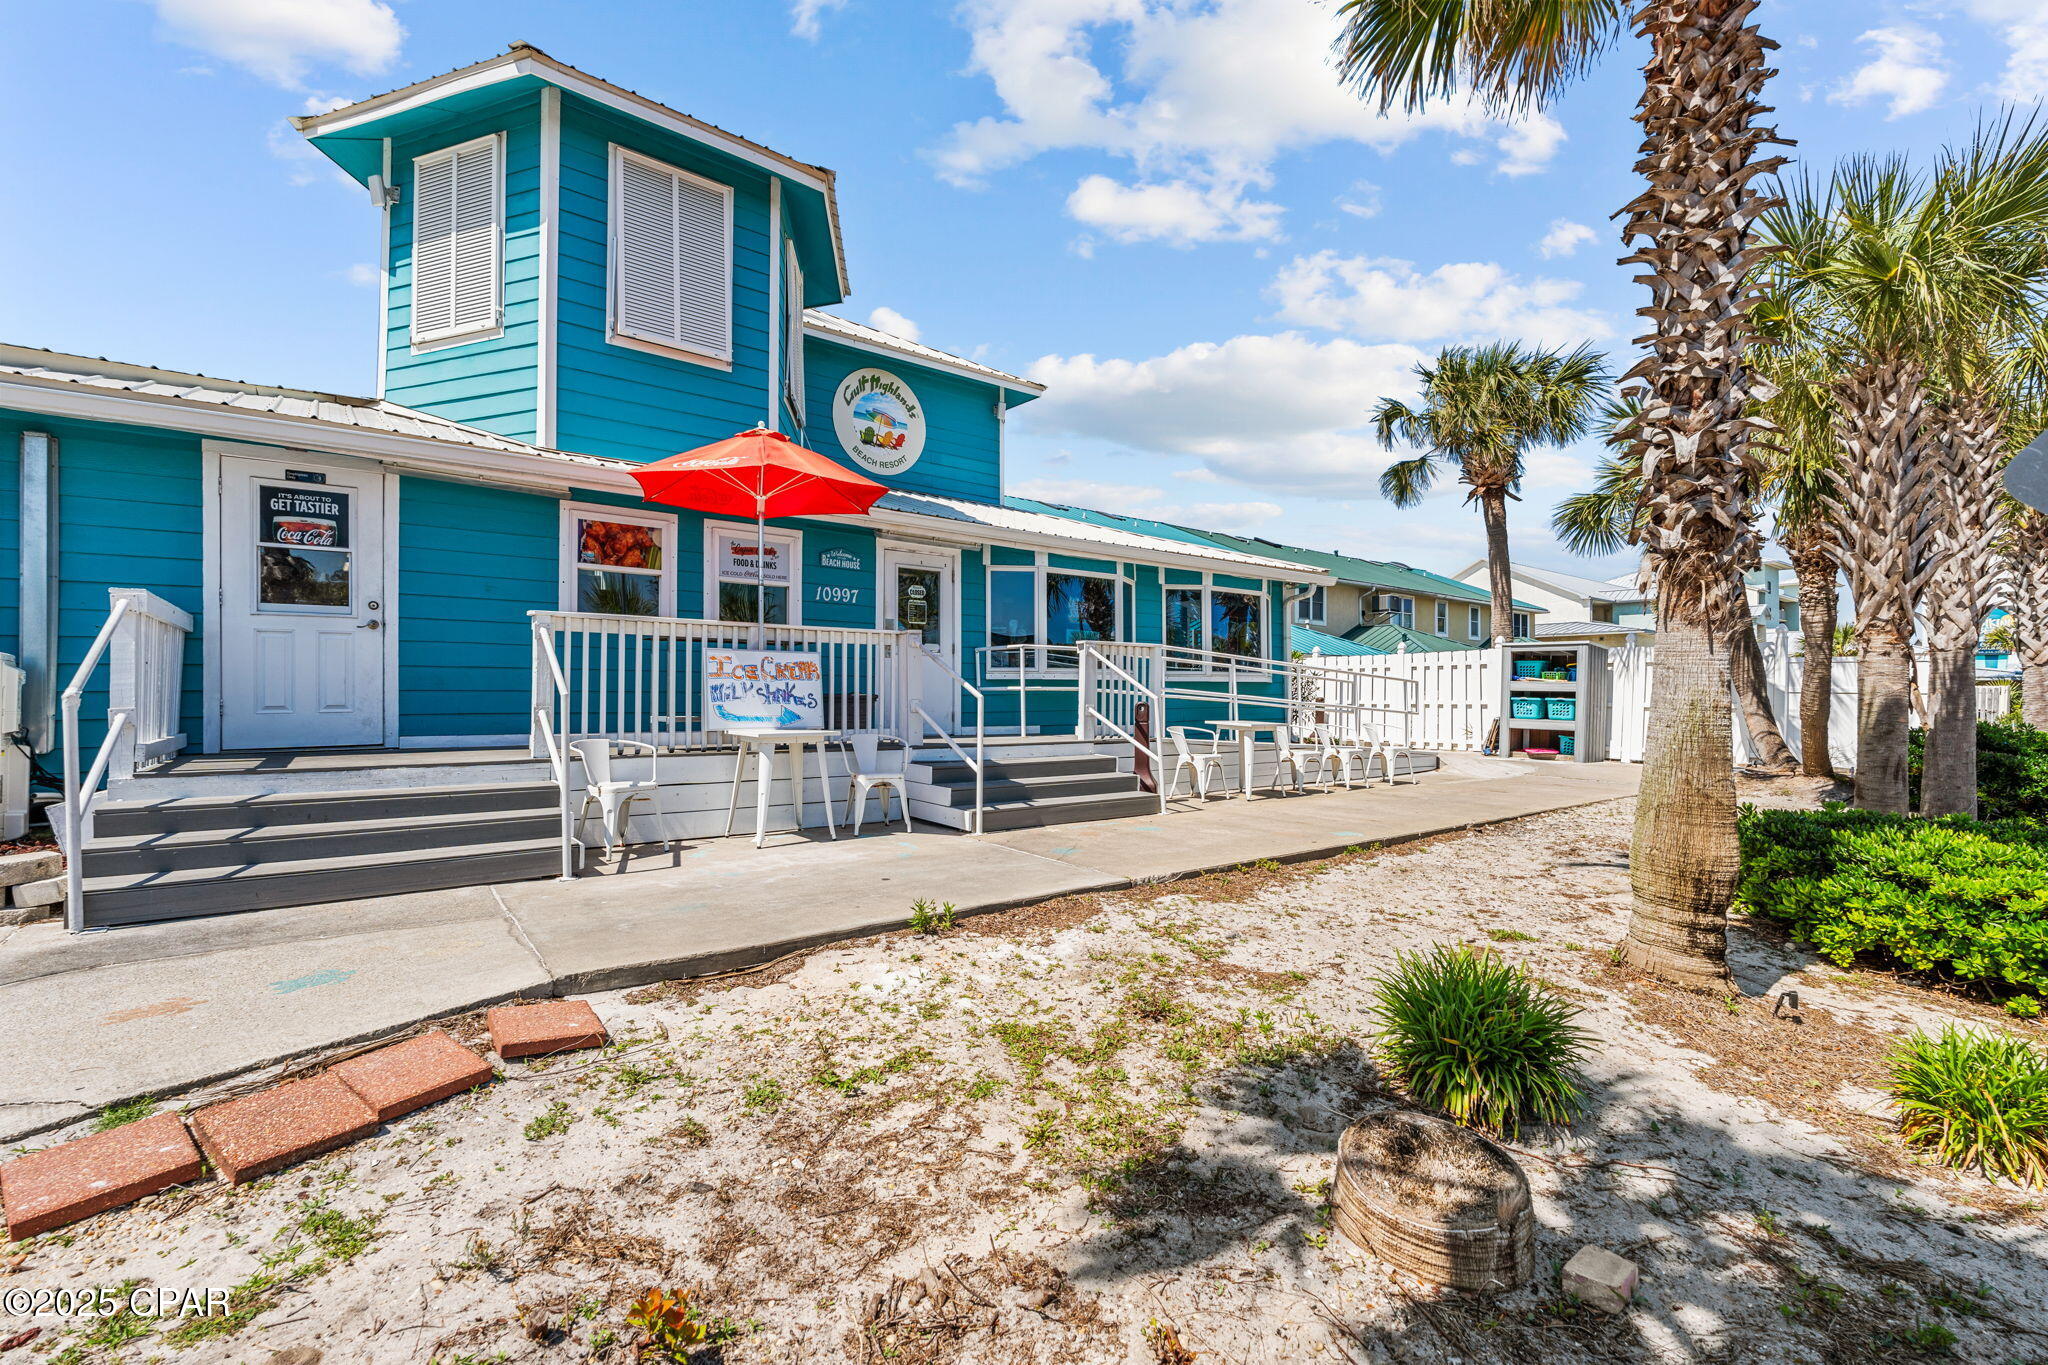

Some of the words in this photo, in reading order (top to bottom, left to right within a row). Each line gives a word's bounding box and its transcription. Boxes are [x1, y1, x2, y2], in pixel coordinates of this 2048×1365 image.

[844, 375, 869, 406] Gulf
[870, 374, 917, 419] Highlands
[852, 445, 877, 466] BEACH
[879, 455, 908, 468] RESORT
[294, 494, 319, 502] ABOUT
[270, 498, 292, 511] GET
[295, 500, 339, 516] TASTIER
[277, 526, 334, 546] Coca-Cola
[733, 558, 749, 567] FOOD
[750, 559, 754, 568] &
[756, 560, 777, 570] DINKS
[822, 554, 841, 567] BEACH
[842, 559, 860, 569] HOUSE
[816, 586, 859, 603] 10997
